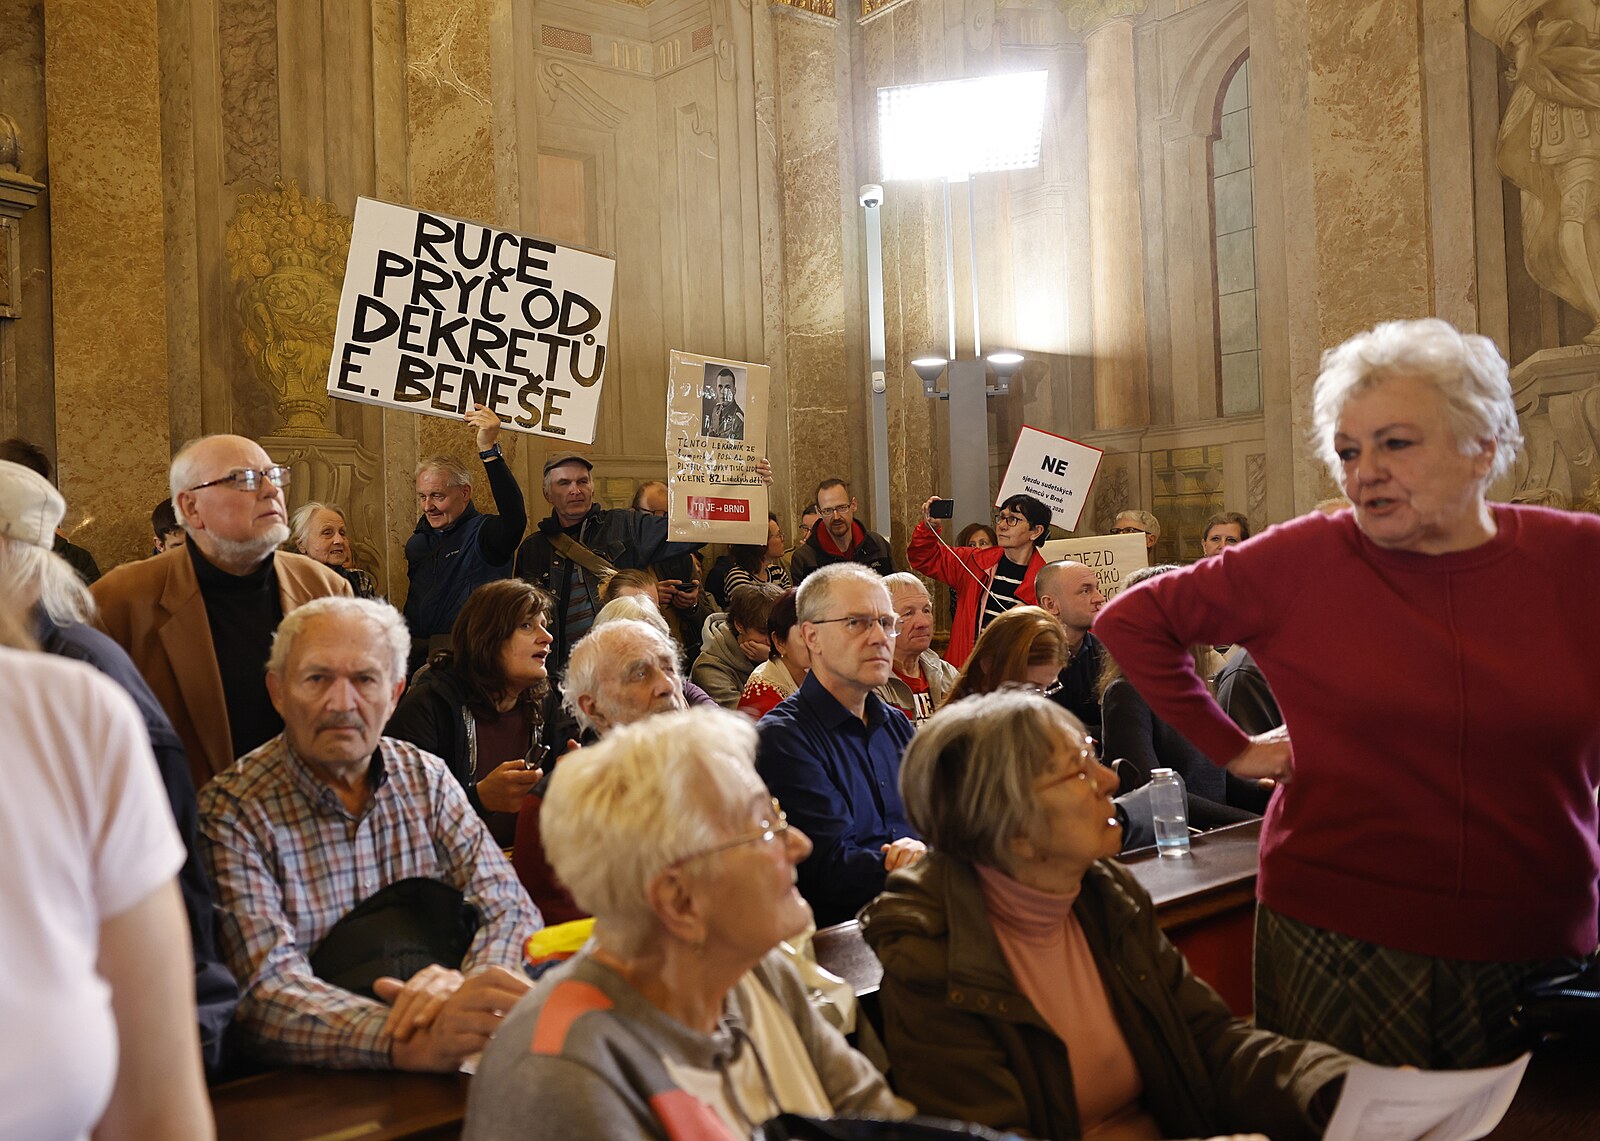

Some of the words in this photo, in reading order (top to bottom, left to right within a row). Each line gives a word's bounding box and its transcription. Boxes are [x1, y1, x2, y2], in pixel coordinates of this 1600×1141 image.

[413, 212, 556, 288] RUCE
[373, 250, 509, 322] PRYČ
[521, 288, 601, 335] OD
[352, 294, 605, 387] DEKRETŮ
[337, 343, 379, 396] E.
[394, 354, 571, 435] BENEŠE
[677, 437, 707, 448] TENTO
[746, 445, 756, 453] ZE
[1041, 455, 1069, 477] NE
[677, 472, 706, 483] VČETNĚ
[709, 474, 721, 483] 82
[1022, 475, 1041, 486] sjezdu
[1041, 481, 1073, 496] sudetských
[1024, 485, 1045, 497] Němců
[1050, 494, 1064, 504] Brně
[694, 502, 704, 511] TO
[706, 503, 716, 512] JE
[723, 504, 745, 514] BRNO
[1052, 505, 1065, 514] 2026
